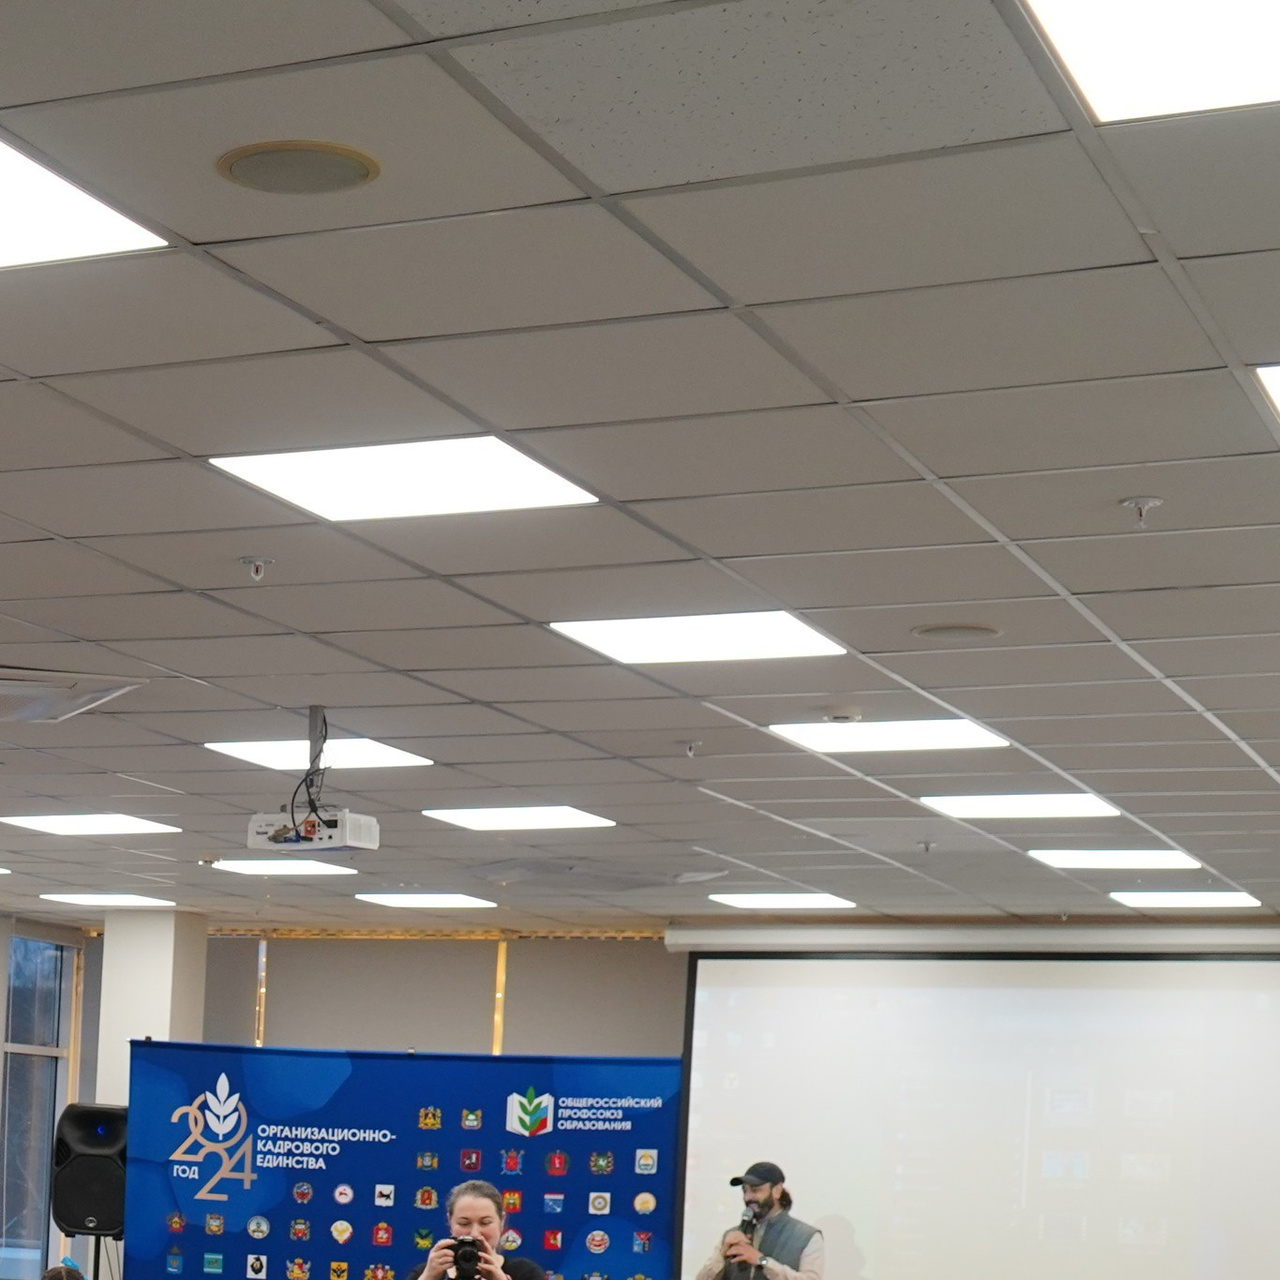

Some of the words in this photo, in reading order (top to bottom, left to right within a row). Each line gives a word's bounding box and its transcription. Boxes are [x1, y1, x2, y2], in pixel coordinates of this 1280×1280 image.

[558, 1096, 663, 1109] ОБЩЕРОССИЙСКИЙ
[558, 1108, 623, 1119] ПРОФСОЮЗ
[557, 1120, 632, 1131] ОБРАЗОВАНИЯ
[257, 1125, 397, 1143] ОРГАНИЗАЦИОННО-
[257, 1139, 340, 1157] КАДРОВОГО
[256, 1155, 326, 1170] ЕДИНСТВА
[173, 1164, 199, 1180] ГОД
